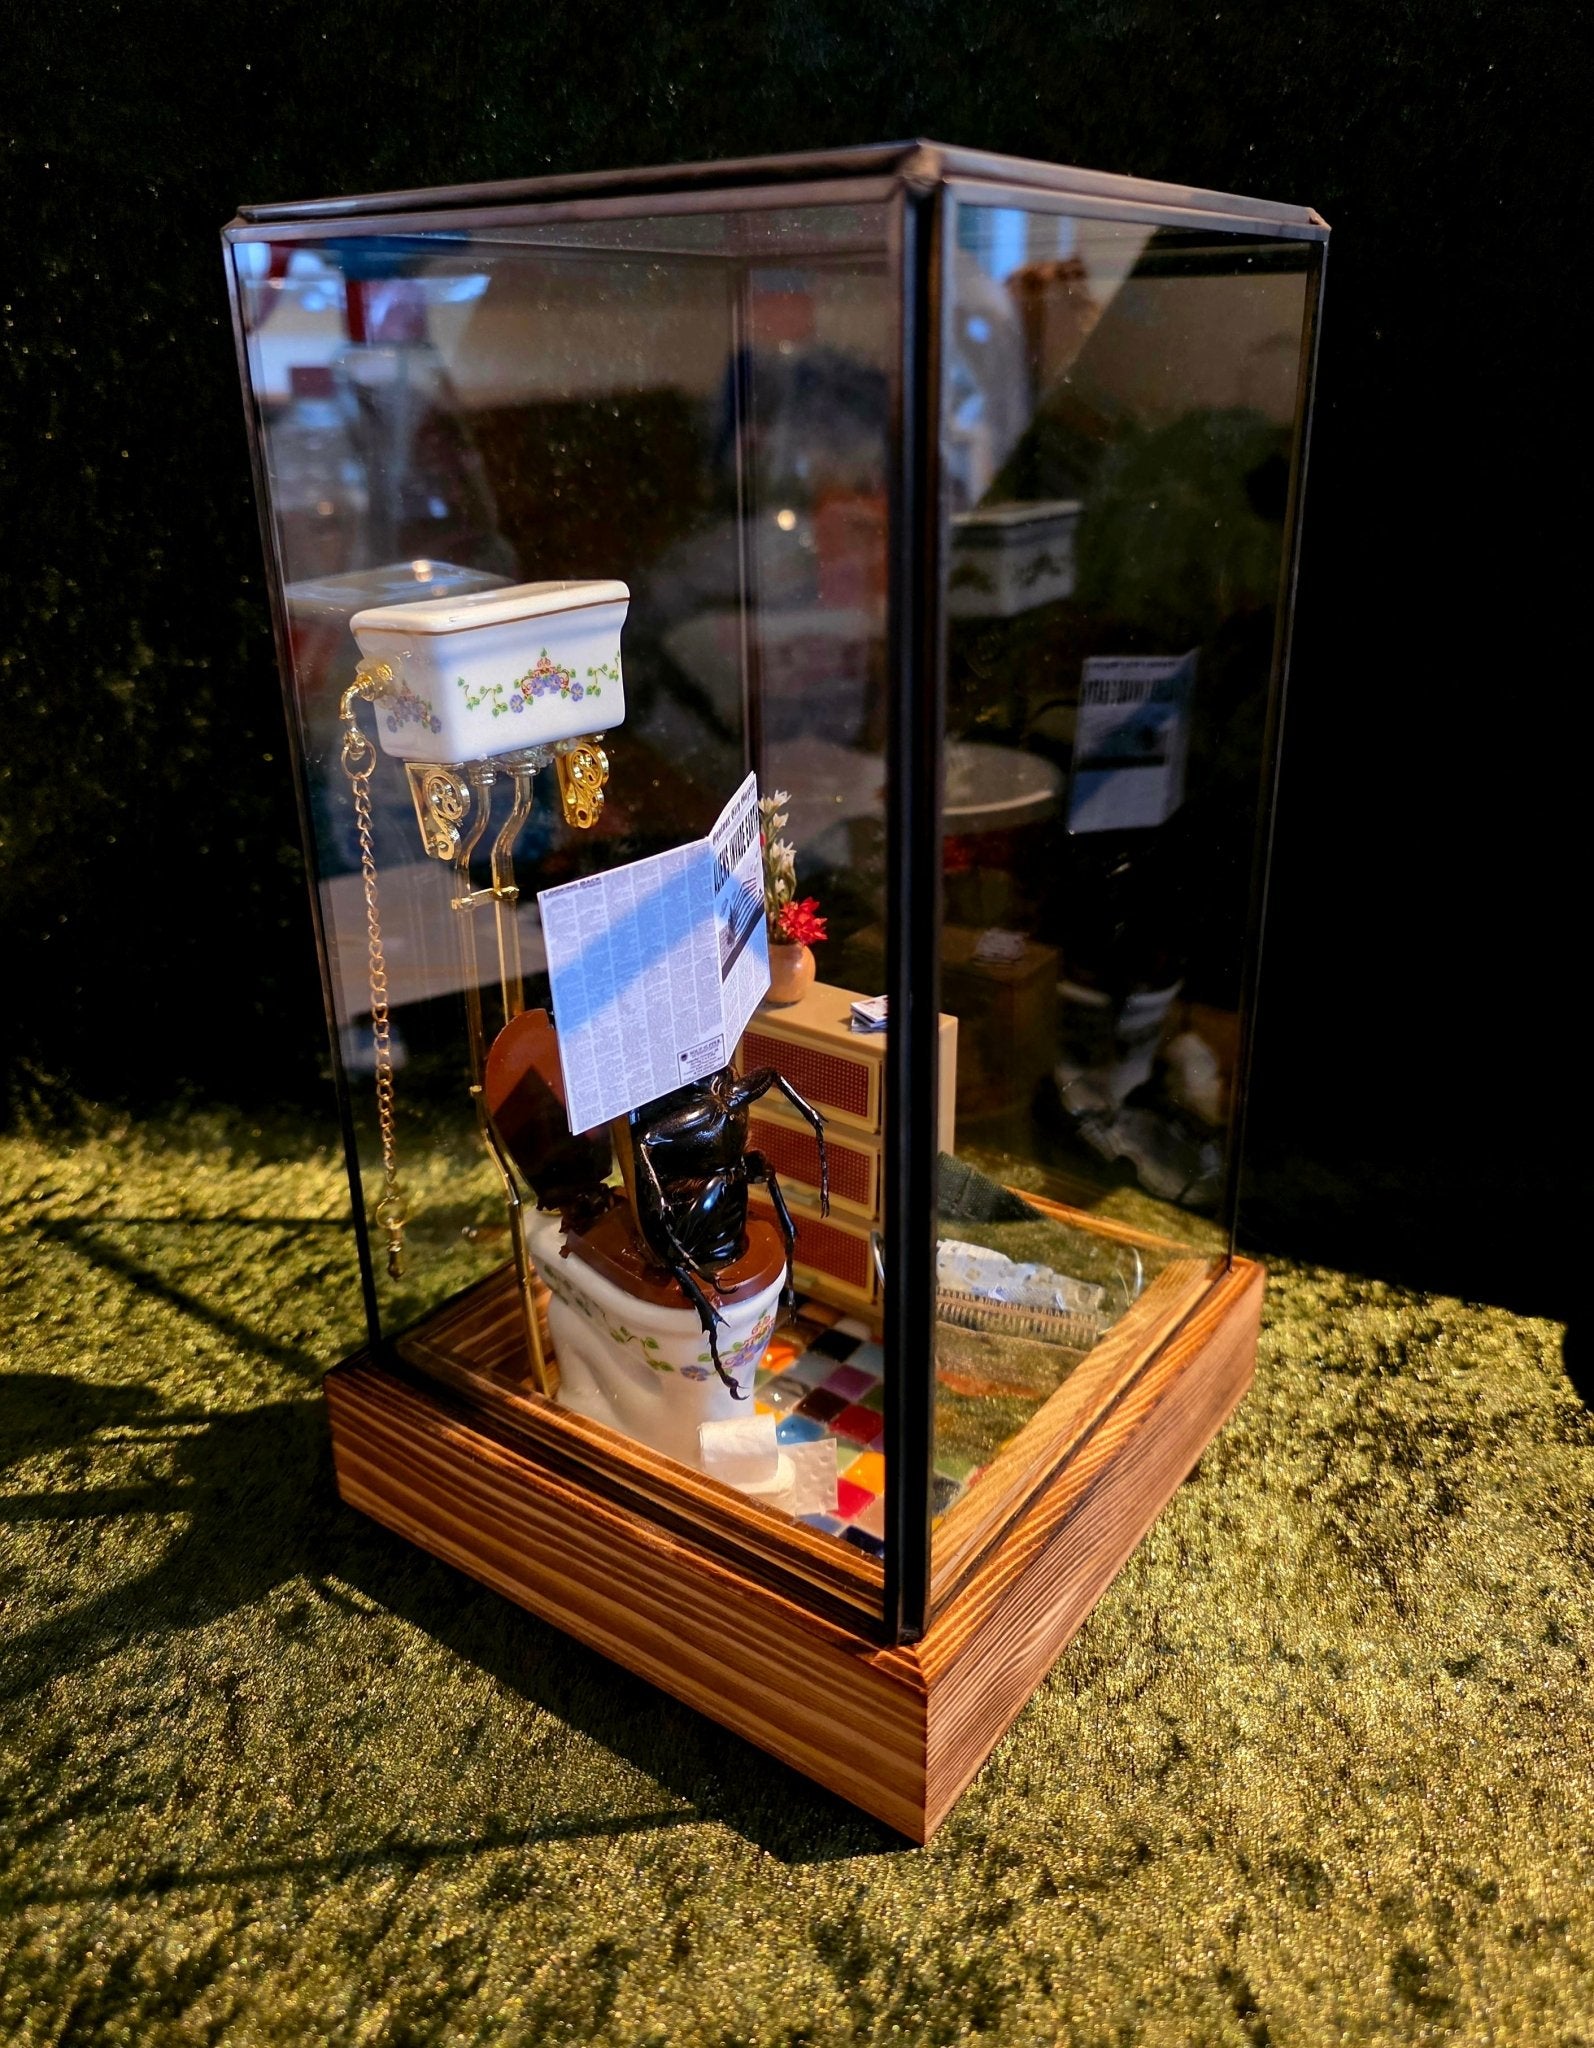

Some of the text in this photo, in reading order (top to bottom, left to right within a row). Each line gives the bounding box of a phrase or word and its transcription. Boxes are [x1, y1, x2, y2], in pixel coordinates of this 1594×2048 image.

[713, 843, 730, 897] ALIENS
[729, 819, 746, 873] INVADE
[745, 799, 760, 848] EARTH
